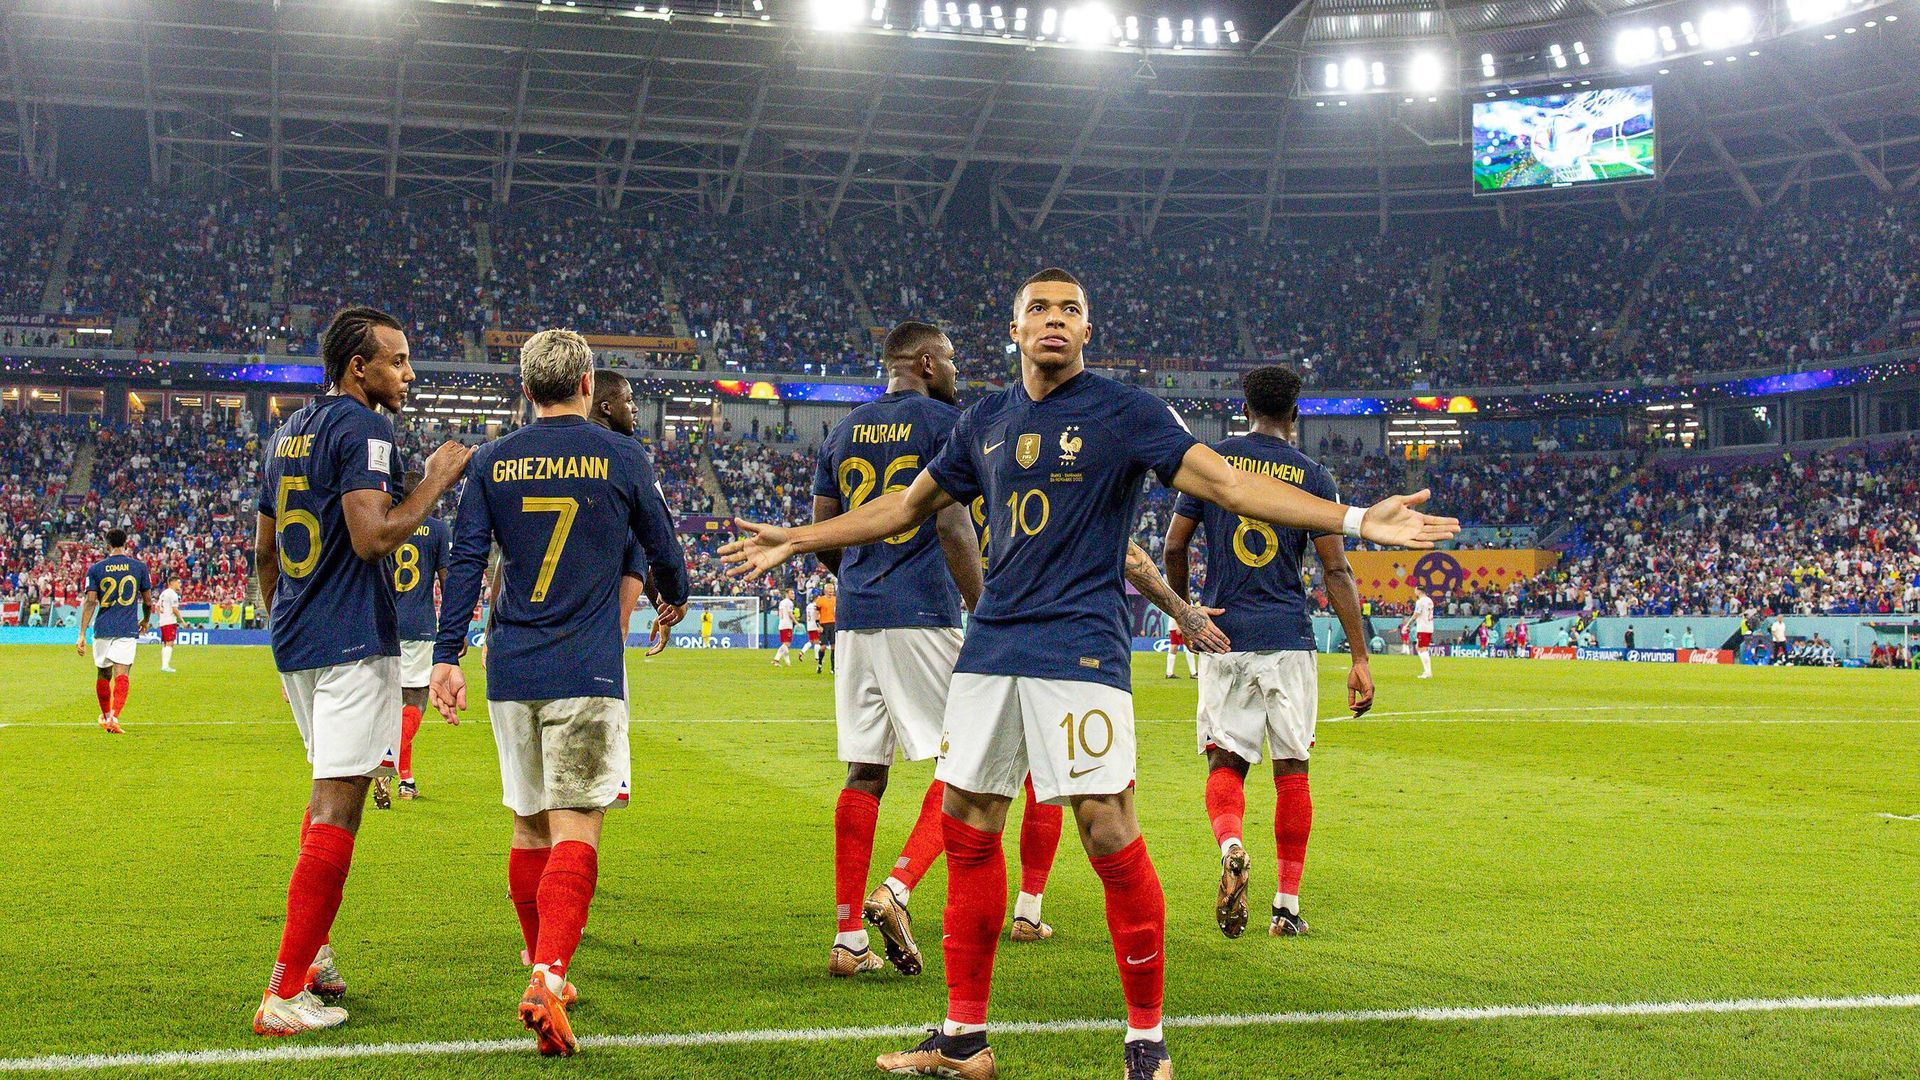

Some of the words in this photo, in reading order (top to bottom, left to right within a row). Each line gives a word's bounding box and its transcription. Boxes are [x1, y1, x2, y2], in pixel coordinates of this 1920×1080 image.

[852, 423, 912, 444] THURAM
[493, 456, 609, 483] GRIEZMANN
[1006, 488, 1050, 538] 10
[275, 475, 322, 580] 5
[413, 525, 430, 537] NO
[522, 496, 580, 603] 7
[105, 564, 129, 572] COMAN
[100, 575, 138, 608] 20
[720, 636, 731, 649] 6
[1451, 645, 1488, 658] Hisense
[1641, 651, 1674, 662] HYUNDAI
[1059, 708, 1114, 761] 10
